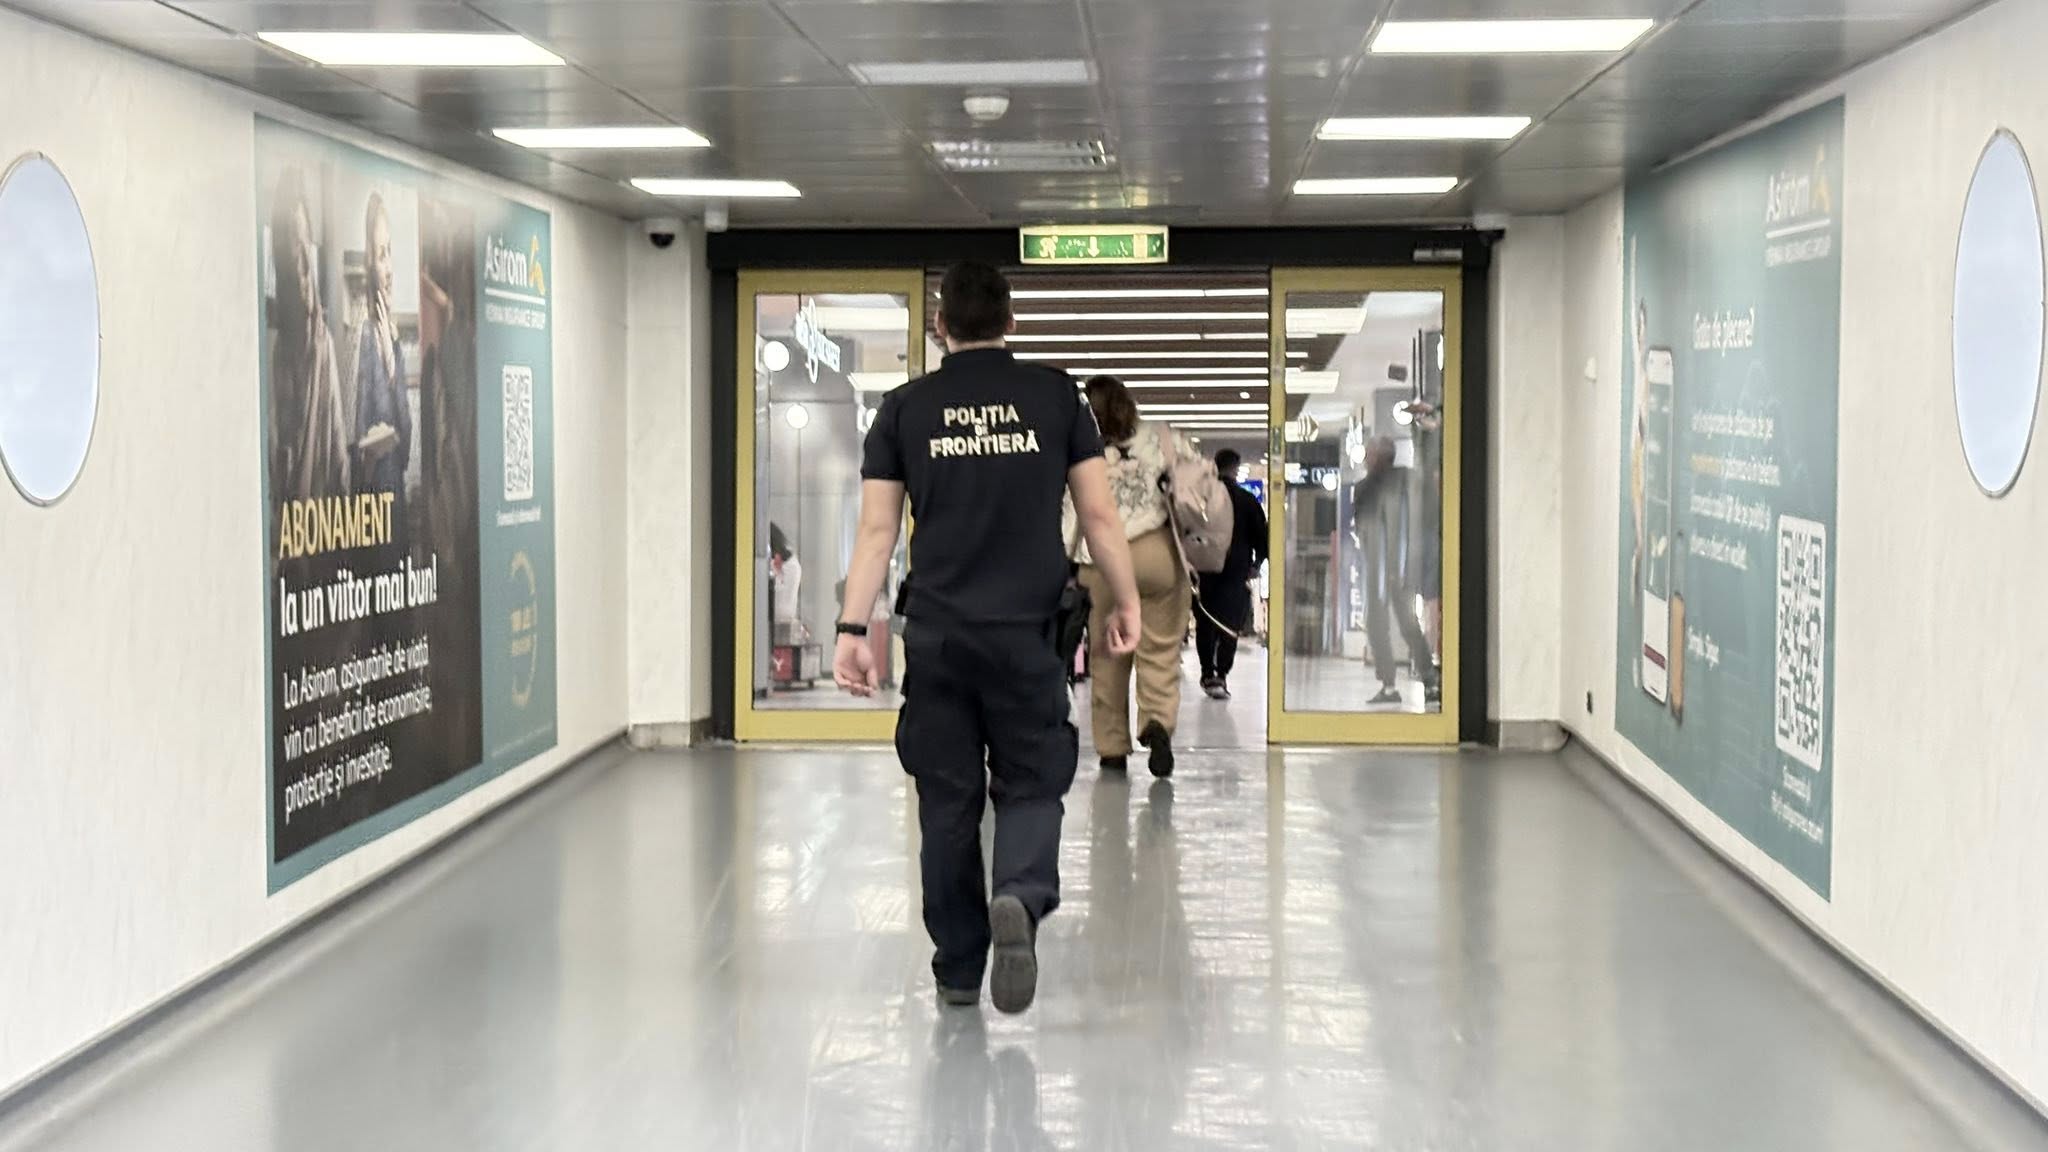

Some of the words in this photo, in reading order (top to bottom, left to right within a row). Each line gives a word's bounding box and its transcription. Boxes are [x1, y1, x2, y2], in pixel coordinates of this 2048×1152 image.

[484, 236, 528, 287] Asirom
[929, 429, 1040, 458] FRONTIERĂ
[279, 492, 395, 560] ABONAMENT
[280, 577, 299, 637] la
[301, 586, 325, 632] un
[327, 568, 373, 624] viitor
[375, 559, 405, 614] mai
[406, 552, 438, 607] bun!
[284, 671, 299, 711] La
[299, 666, 340, 705] Asirom,
[393, 640, 406, 675] de
[284, 724, 301, 763] vin
[303, 724, 317, 754] cu
[318, 700, 363, 749] beneficii
[363, 695, 377, 732] de
[285, 762, 334, 826] protecție
